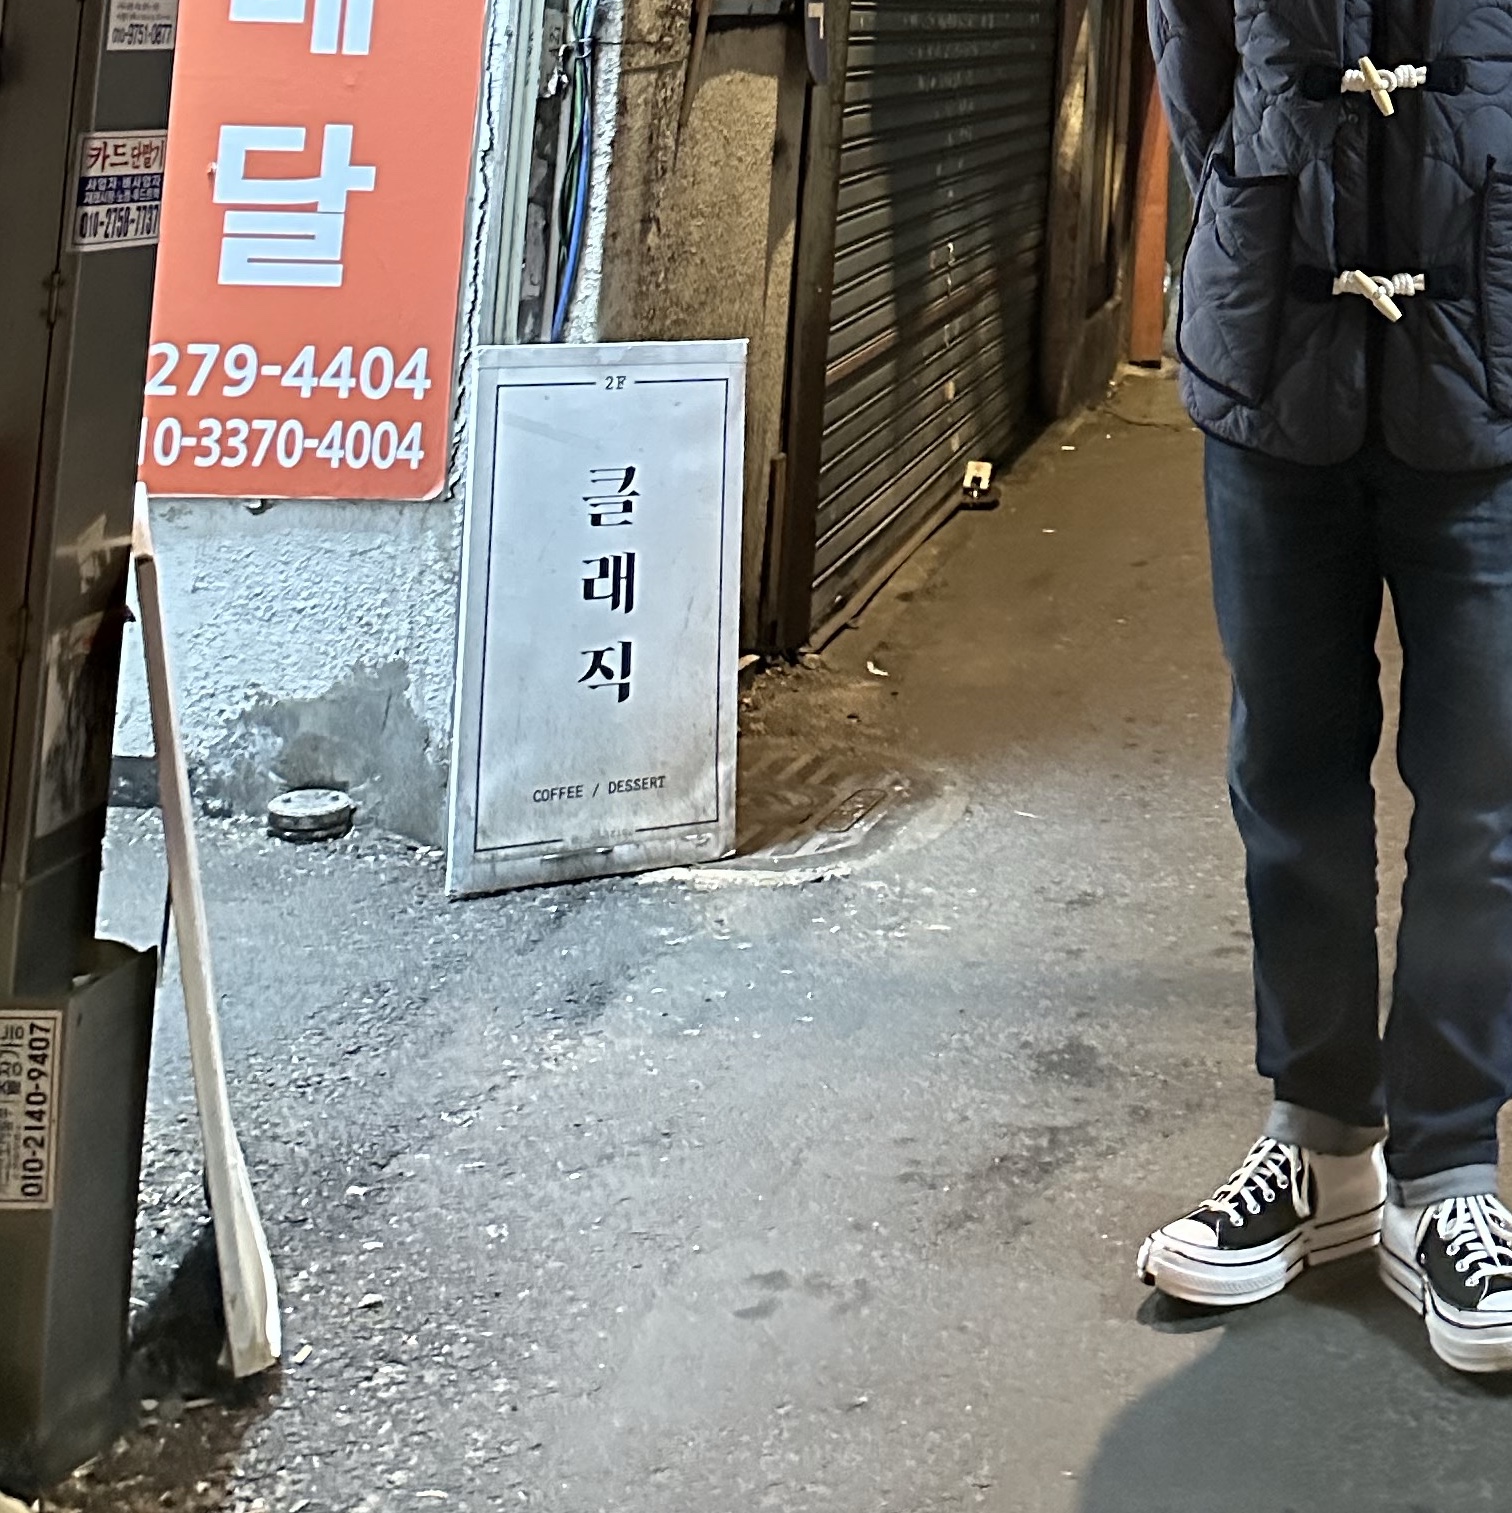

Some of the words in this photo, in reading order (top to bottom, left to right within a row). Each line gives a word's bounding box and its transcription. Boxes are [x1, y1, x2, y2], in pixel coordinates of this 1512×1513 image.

[604, 375, 627, 391] 2F
[577, 465, 640, 704] 클래직
[532, 785, 584, 803] COFFEE
[607, 775, 667, 794] DESSERT
[20, 1022, 51, 1197] 010-2140-9407
